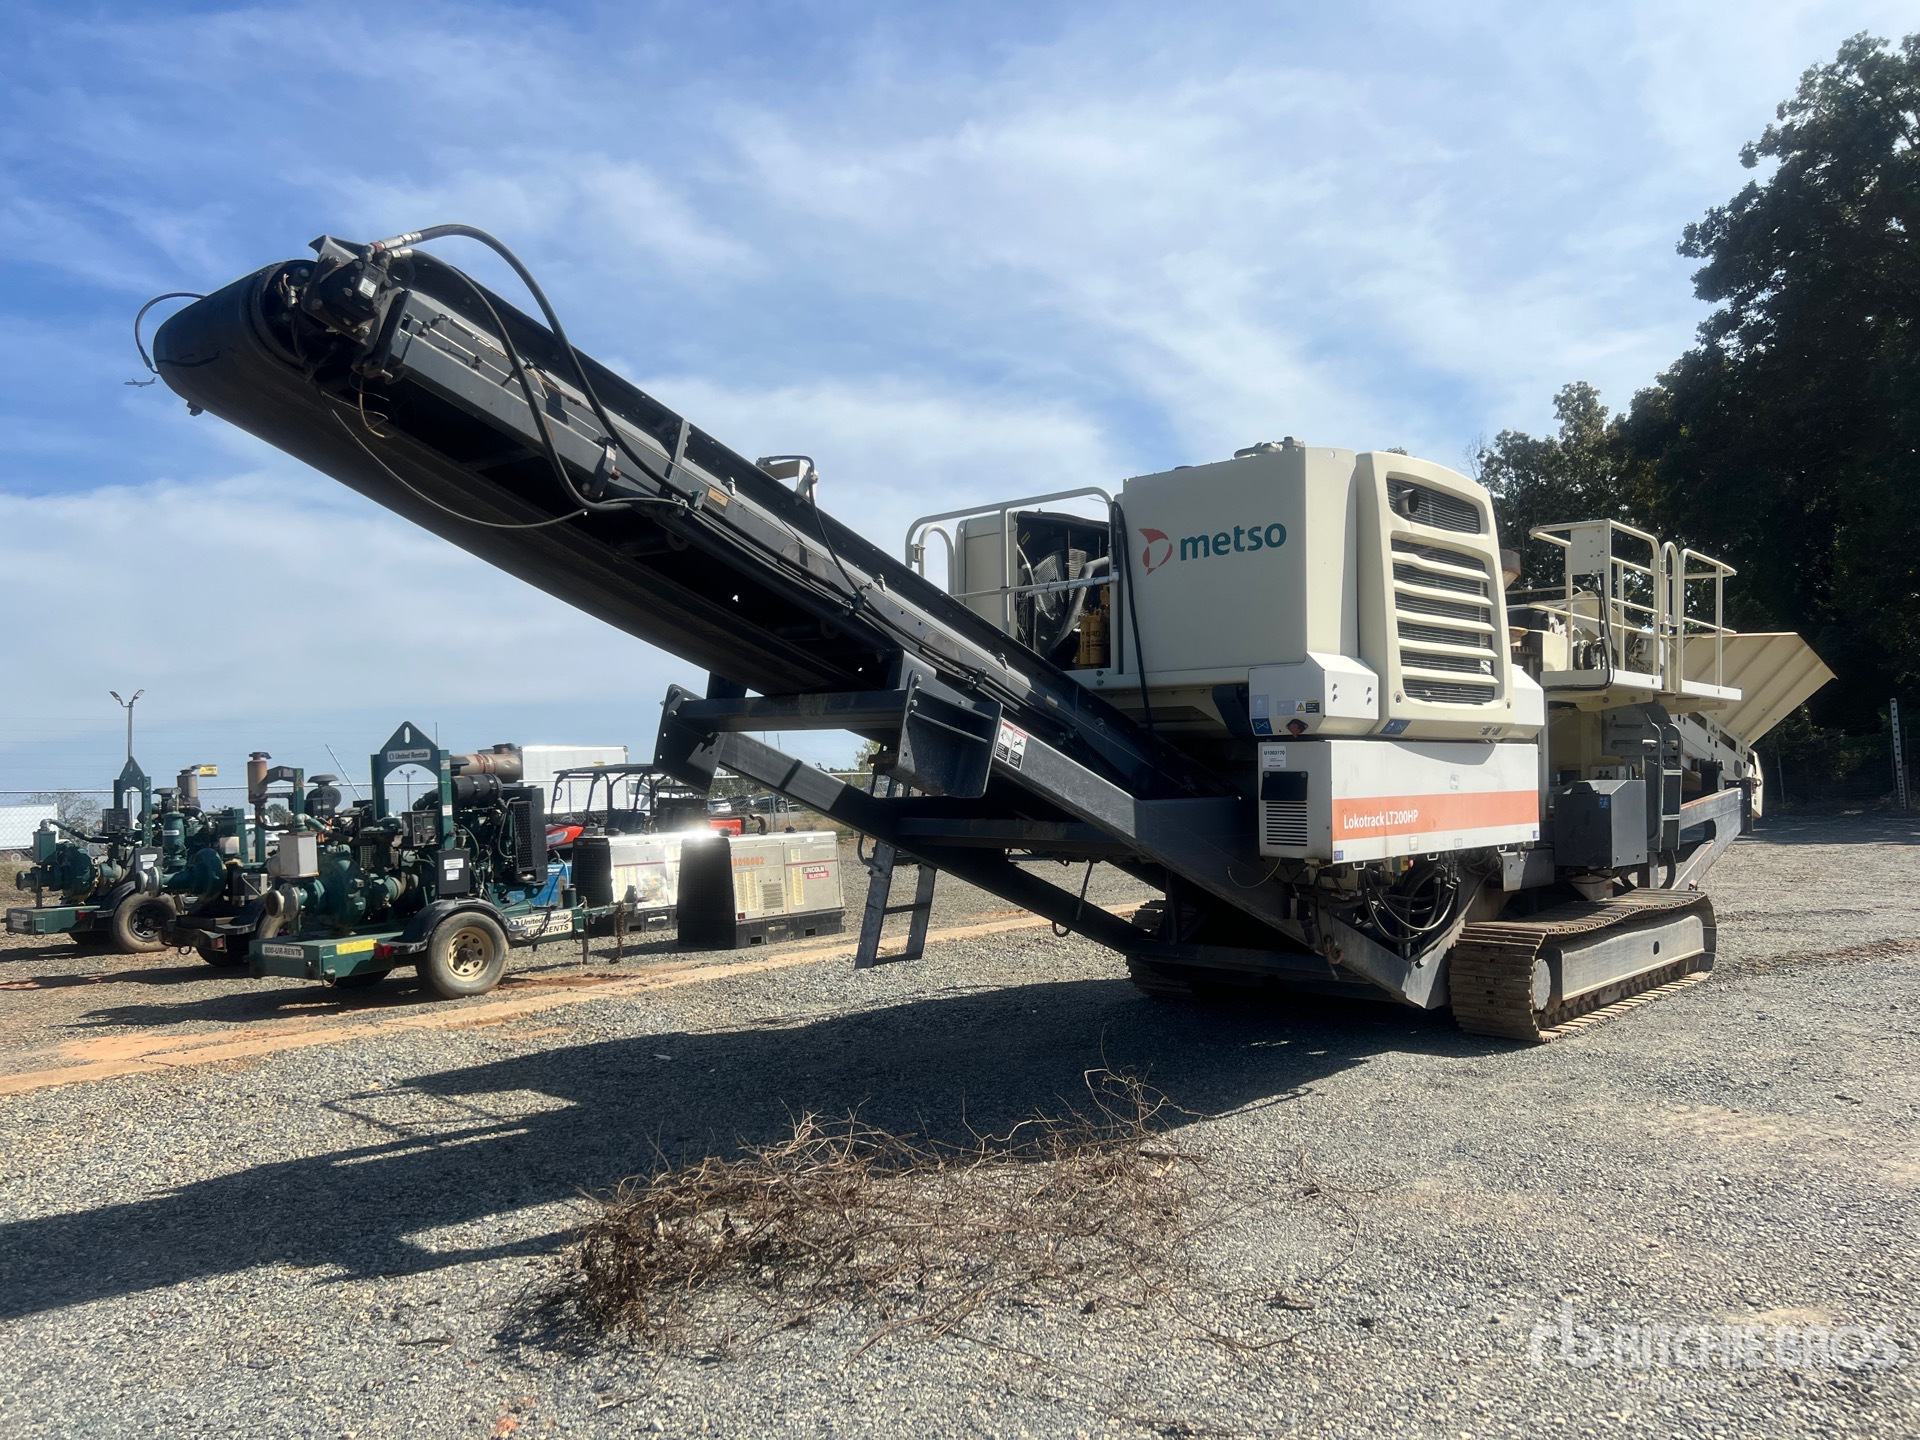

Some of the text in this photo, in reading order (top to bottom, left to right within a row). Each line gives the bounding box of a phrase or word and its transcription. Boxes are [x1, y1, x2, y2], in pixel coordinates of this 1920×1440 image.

[1180, 522, 1287, 561] metso
[1343, 809, 1418, 829] Lokotrack LT200HP
[520, 916, 543, 926] United
[264, 946, 302, 956] 800-UR-RENTS
